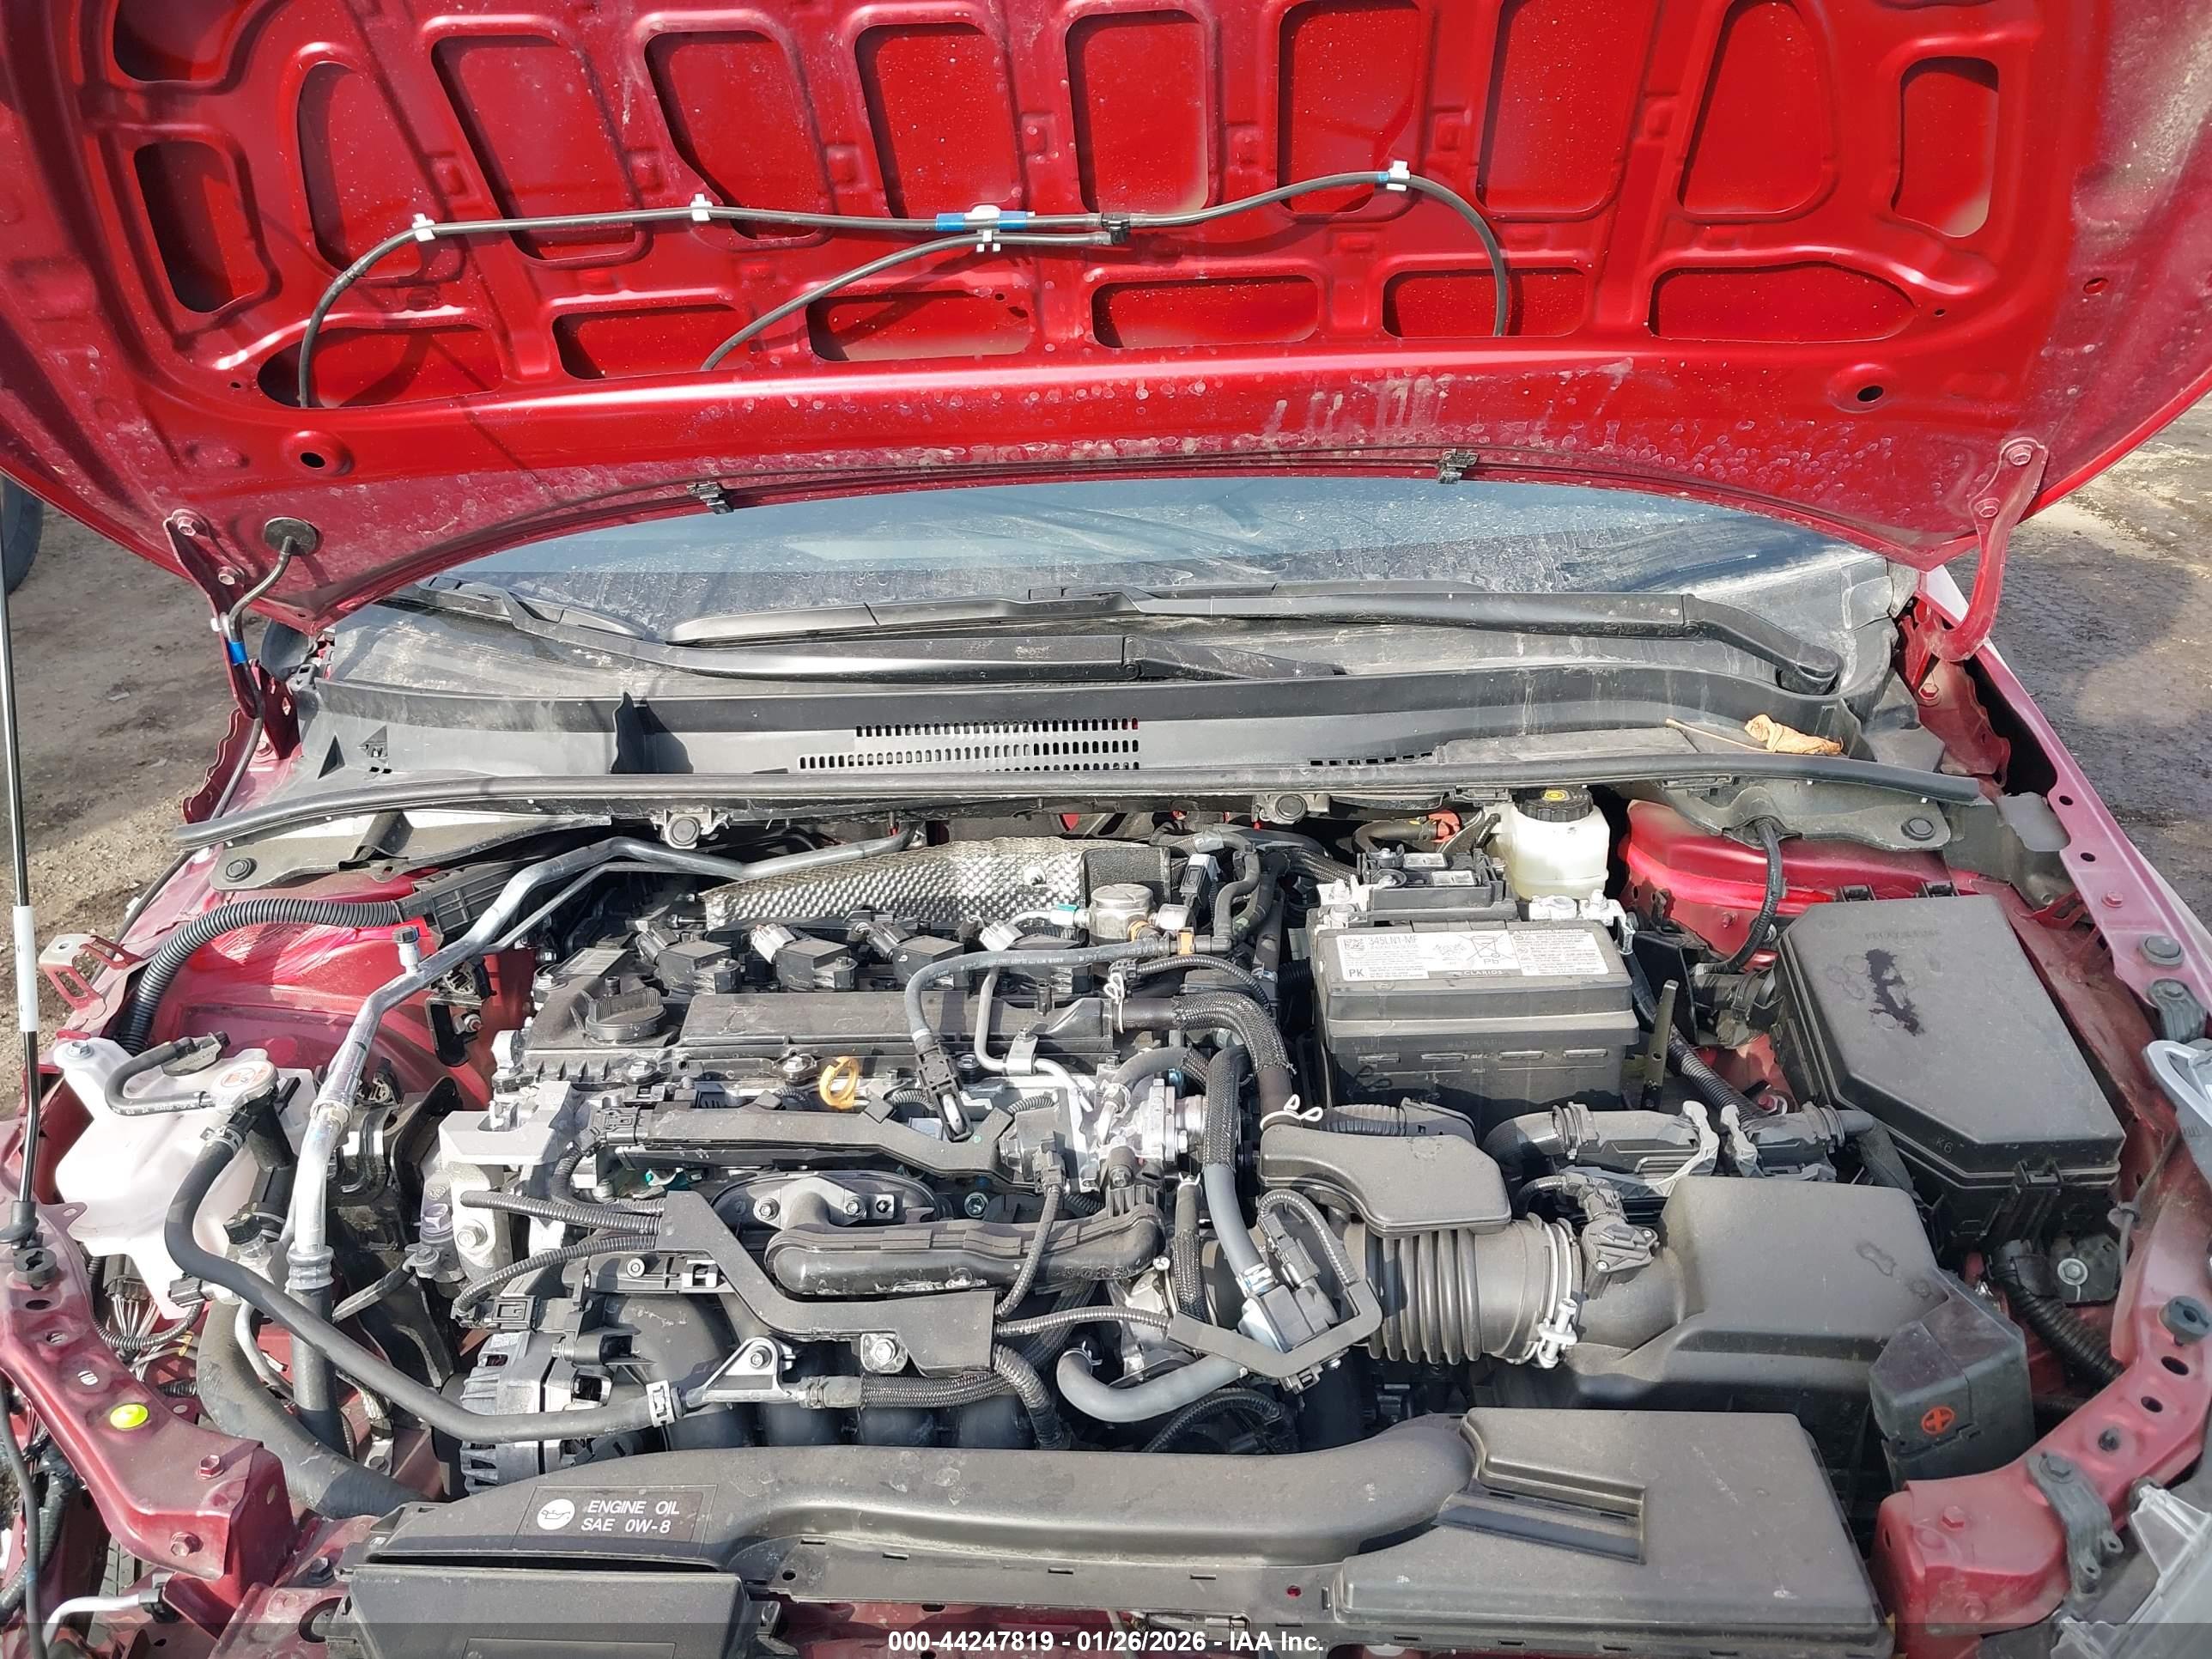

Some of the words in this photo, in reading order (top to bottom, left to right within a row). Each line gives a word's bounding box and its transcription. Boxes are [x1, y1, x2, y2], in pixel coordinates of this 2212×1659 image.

[1349, 968, 1365, 977] PK
[586, 1499, 647, 1514] ENGINE
[654, 1500, 680, 1515] OIL
[580, 1517, 616, 1532] SAE
[624, 1518, 672, 1534] 0W-8
